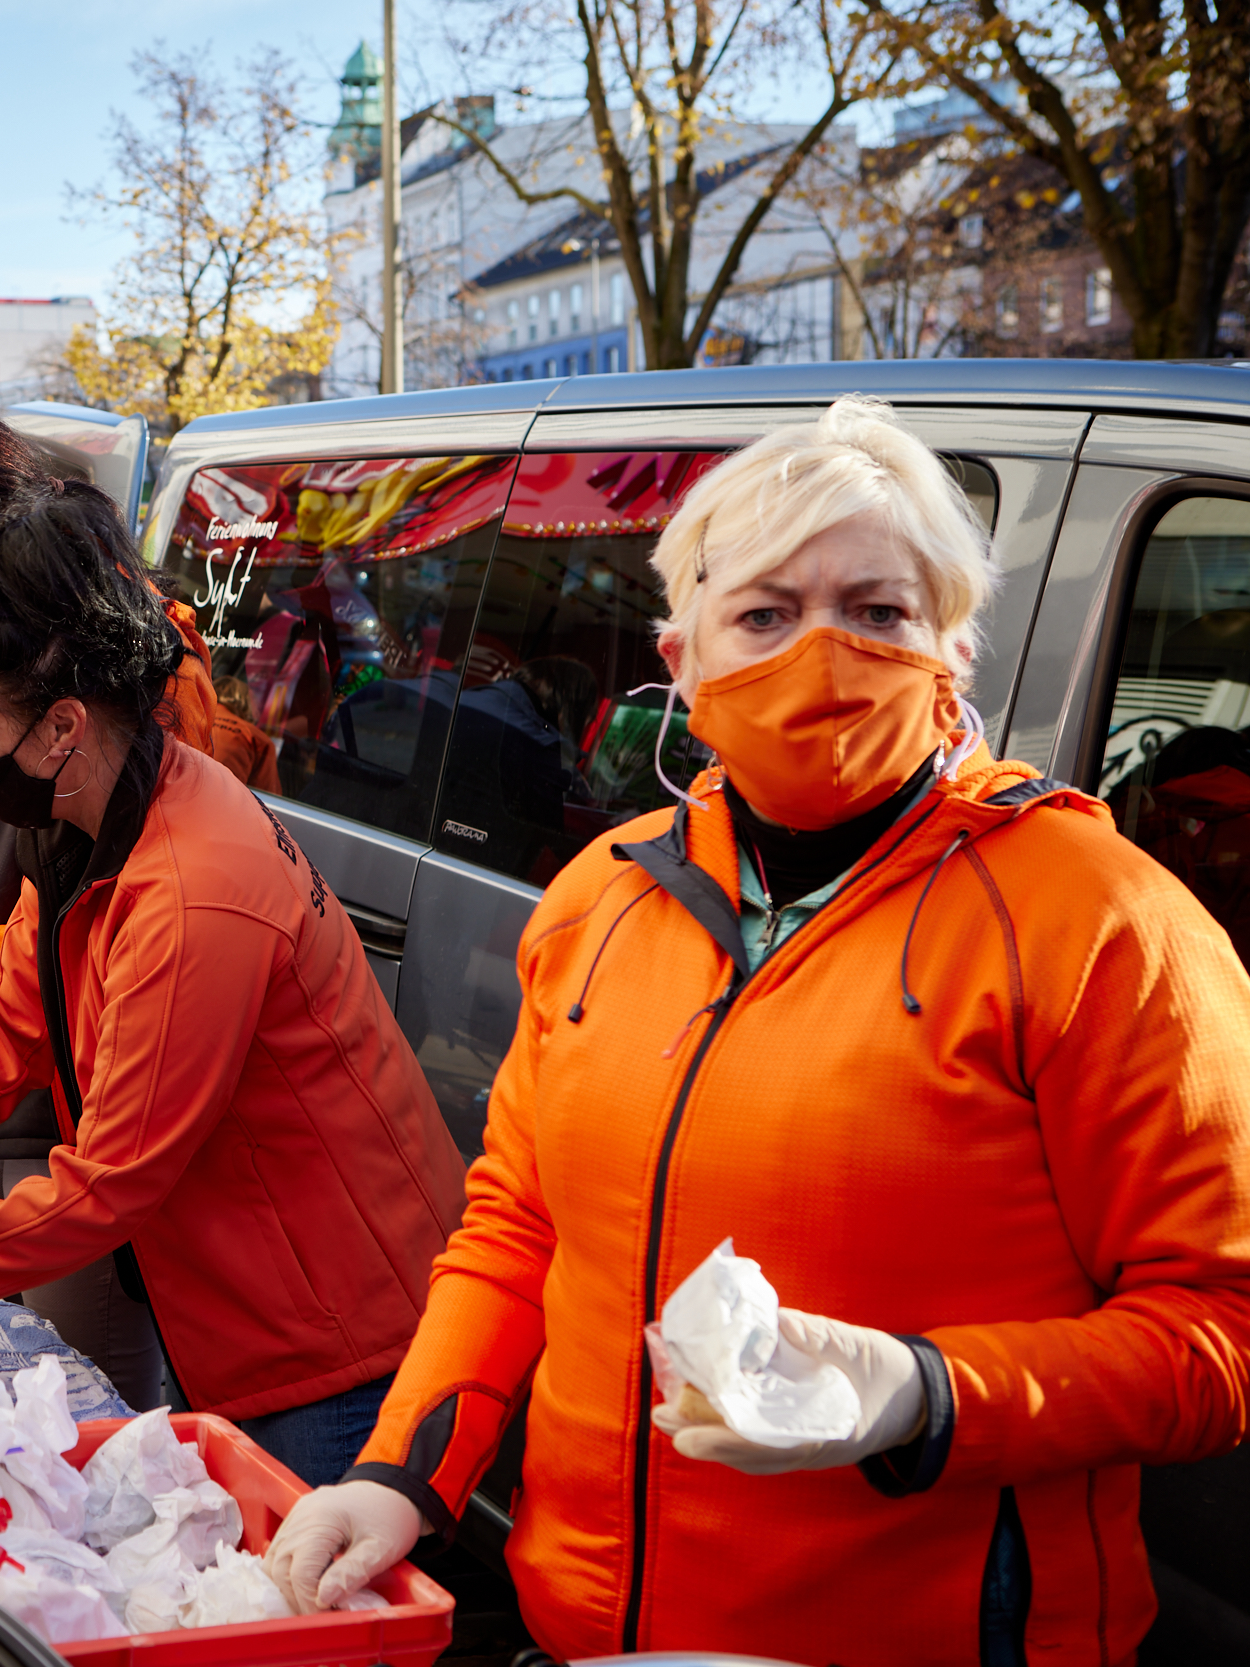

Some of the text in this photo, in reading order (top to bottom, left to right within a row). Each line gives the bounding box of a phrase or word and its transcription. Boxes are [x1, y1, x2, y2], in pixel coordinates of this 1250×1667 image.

[205, 514, 279, 541] Ferienwohnung
[193, 545, 258, 638] Sylt
[444, 821, 485, 842] PANORAMA
